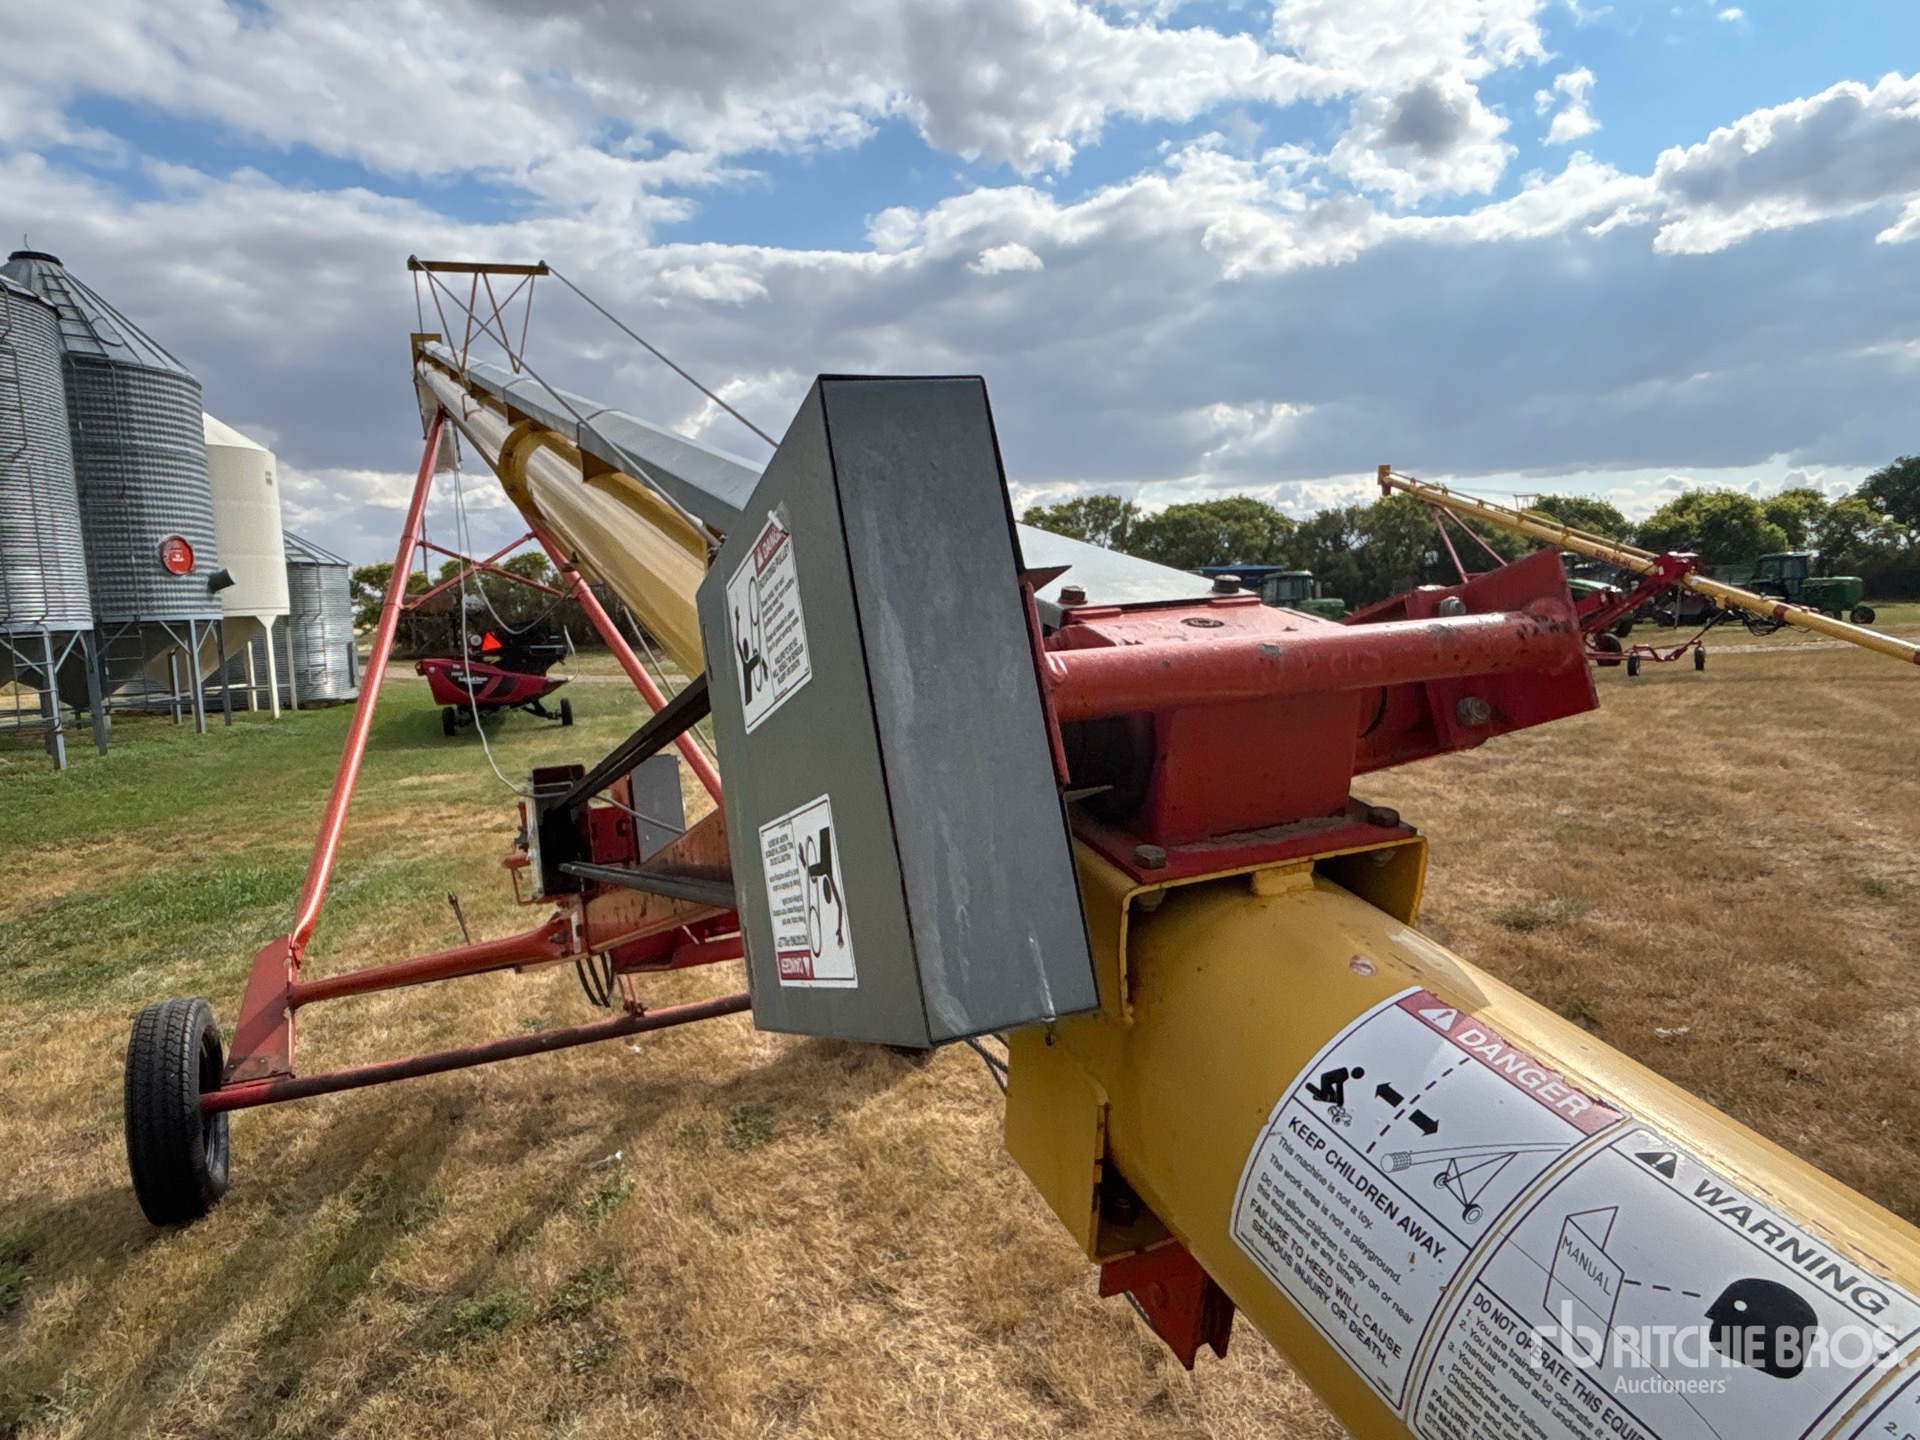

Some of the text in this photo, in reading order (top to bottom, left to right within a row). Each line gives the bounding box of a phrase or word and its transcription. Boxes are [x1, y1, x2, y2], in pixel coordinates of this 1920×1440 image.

[1456, 1029, 1591, 1118] DANGER
[1269, 1152, 1284, 1172] The
[1283, 1169, 1304, 1191] work
[1302, 1187, 1321, 1209] area
[1320, 1204, 1330, 1216] is
[1328, 1212, 1345, 1230] not
[1349, 1233, 1402, 1286] playground.
[1278, 1135, 1295, 1156] This
[1293, 1153, 1328, 1186] machine
[1327, 1181, 1336, 1194] is
[1335, 1191, 1352, 1209] not
[1357, 1210, 1374, 1230] toy.
[1288, 1116, 1447, 1264] KEEP CHILDREN AWAY.
[1249, 1198, 1290, 1244] FAILURE
[1290, 1238, 1304, 1259] TO
[1304, 1254, 1333, 1289] HEED
[1335, 1283, 1360, 1318] WILL
[1362, 1313, 1403, 1360] CAUSE
[1257, 1182, 1356, 1288] this equipment at any time.
[1260, 1171, 1414, 1325] Do not allow children to play on or near
[1561, 1235, 1611, 1297] MANUAL
[1693, 1178, 1891, 1316] WARNING
[1252, 1219, 1293, 1267] SERIOUS
[1293, 1262, 1331, 1305] INJURY
[1331, 1301, 1348, 1325] OR
[1348, 1319, 1388, 1368] DEATH.
[1449, 1362, 1522, 1432] procedures and
[1458, 1349, 1474, 1371] You
[1474, 1367, 1500, 1394] know
[1499, 1393, 1520, 1414] and
[1462, 1340, 1496, 1376] manual.
[1469, 1327, 1486, 1348] You
[1485, 1344, 1509, 1370] have
[1508, 1367, 1532, 1390] read
[1531, 1388, 1553, 1409] and
[1472, 1292, 1492, 1314] DO
[1489, 1307, 1518, 1336] NOT
[1515, 1330, 1574, 1387] OPERATE
[1572, 1378, 1603, 1414] THIS
[1475, 1316, 1493, 1337] You
[1491, 1335, 1508, 1352] are
[1508, 1347, 1543, 1383] trained
[1542, 1378, 1554, 1393] to
[1554, 1391, 1595, 1430] operate
[1428, 1388, 1471, 1434] FAILURE
[1442, 1384, 1482, 1425] removed
[1447, 1372, 1483, 1412] Children
[1483, 1410, 1503, 1431] and
